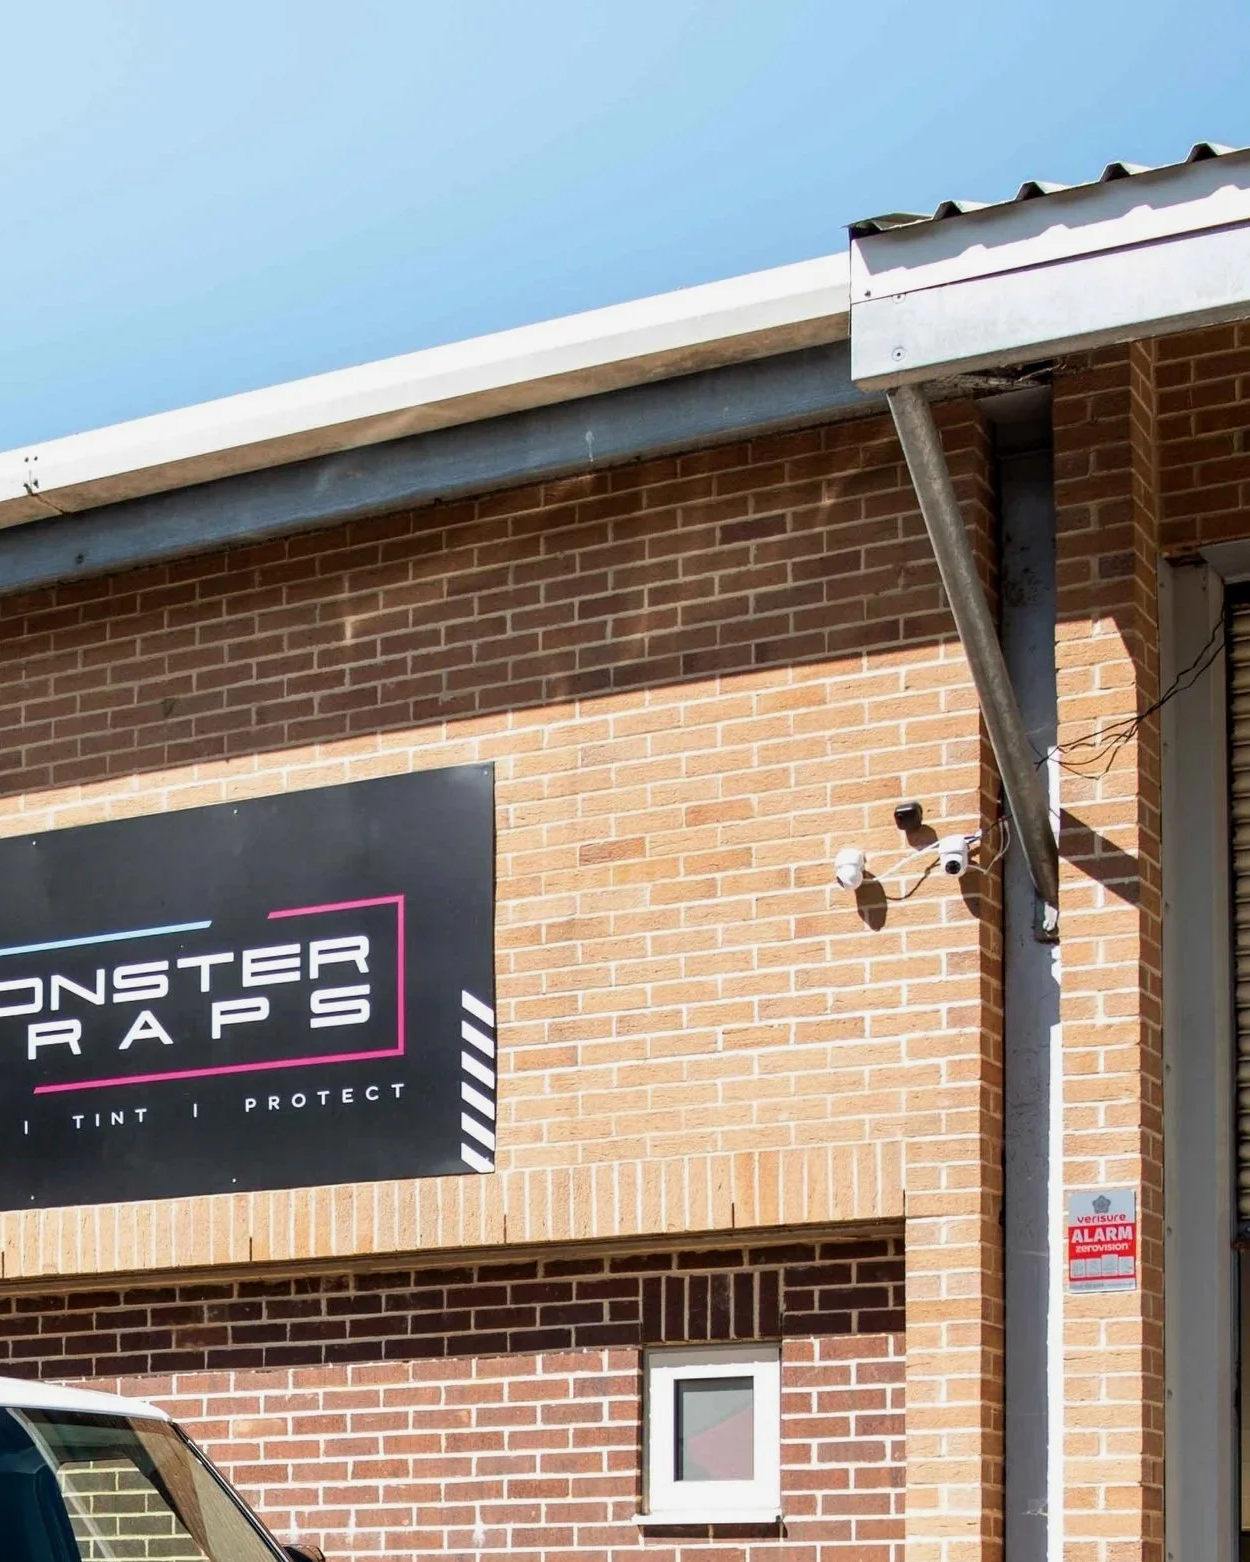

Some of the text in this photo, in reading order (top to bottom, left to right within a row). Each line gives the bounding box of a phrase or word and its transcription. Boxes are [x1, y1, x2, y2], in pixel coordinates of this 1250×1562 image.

[73, 1108, 147, 1129] TINT
[246, 1083, 405, 1113] PROTECT
[1077, 1212, 1126, 1223] verisure
[1071, 1225, 1133, 1243] ALARM
